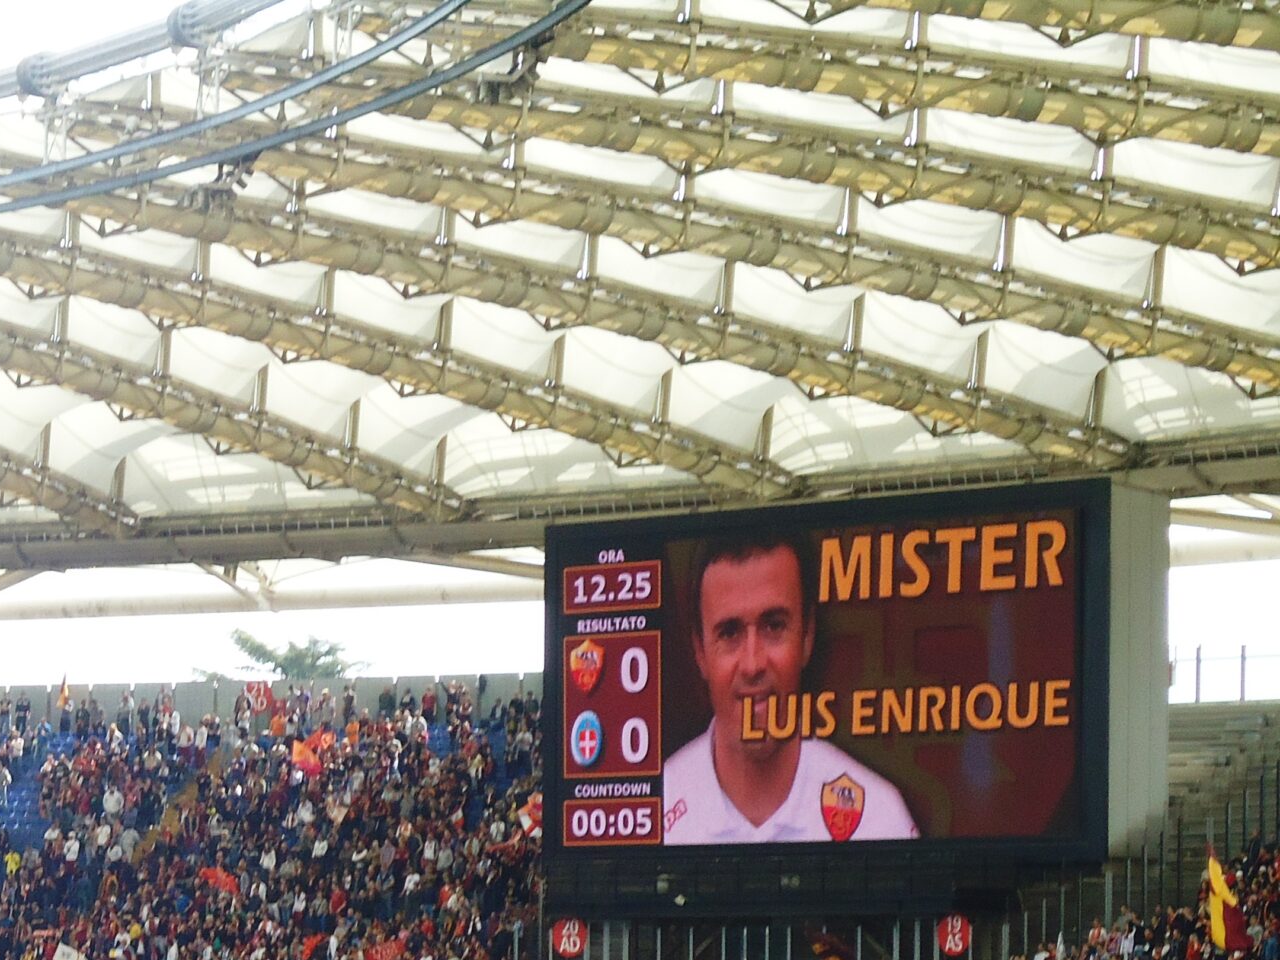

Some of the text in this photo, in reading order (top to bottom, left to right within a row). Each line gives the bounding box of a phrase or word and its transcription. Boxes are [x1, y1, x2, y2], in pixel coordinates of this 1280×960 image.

[598, 548, 625, 564] ORA
[818, 519, 1067, 603] MISTER
[573, 570, 652, 604] 12.25
[577, 615, 647, 633] RISULTATO
[620, 646, 649, 693] 0
[740, 679, 1071, 741] LUIS ENRIQUE
[620, 716, 650, 764] 0
[574, 782, 651, 798] COUNTDOWN
[571, 807, 653, 838] 00:05
[561, 919, 579, 936] 20
[947, 915, 962, 934] 19
[559, 935, 581, 954] AD
[945, 933, 964, 952] AS
